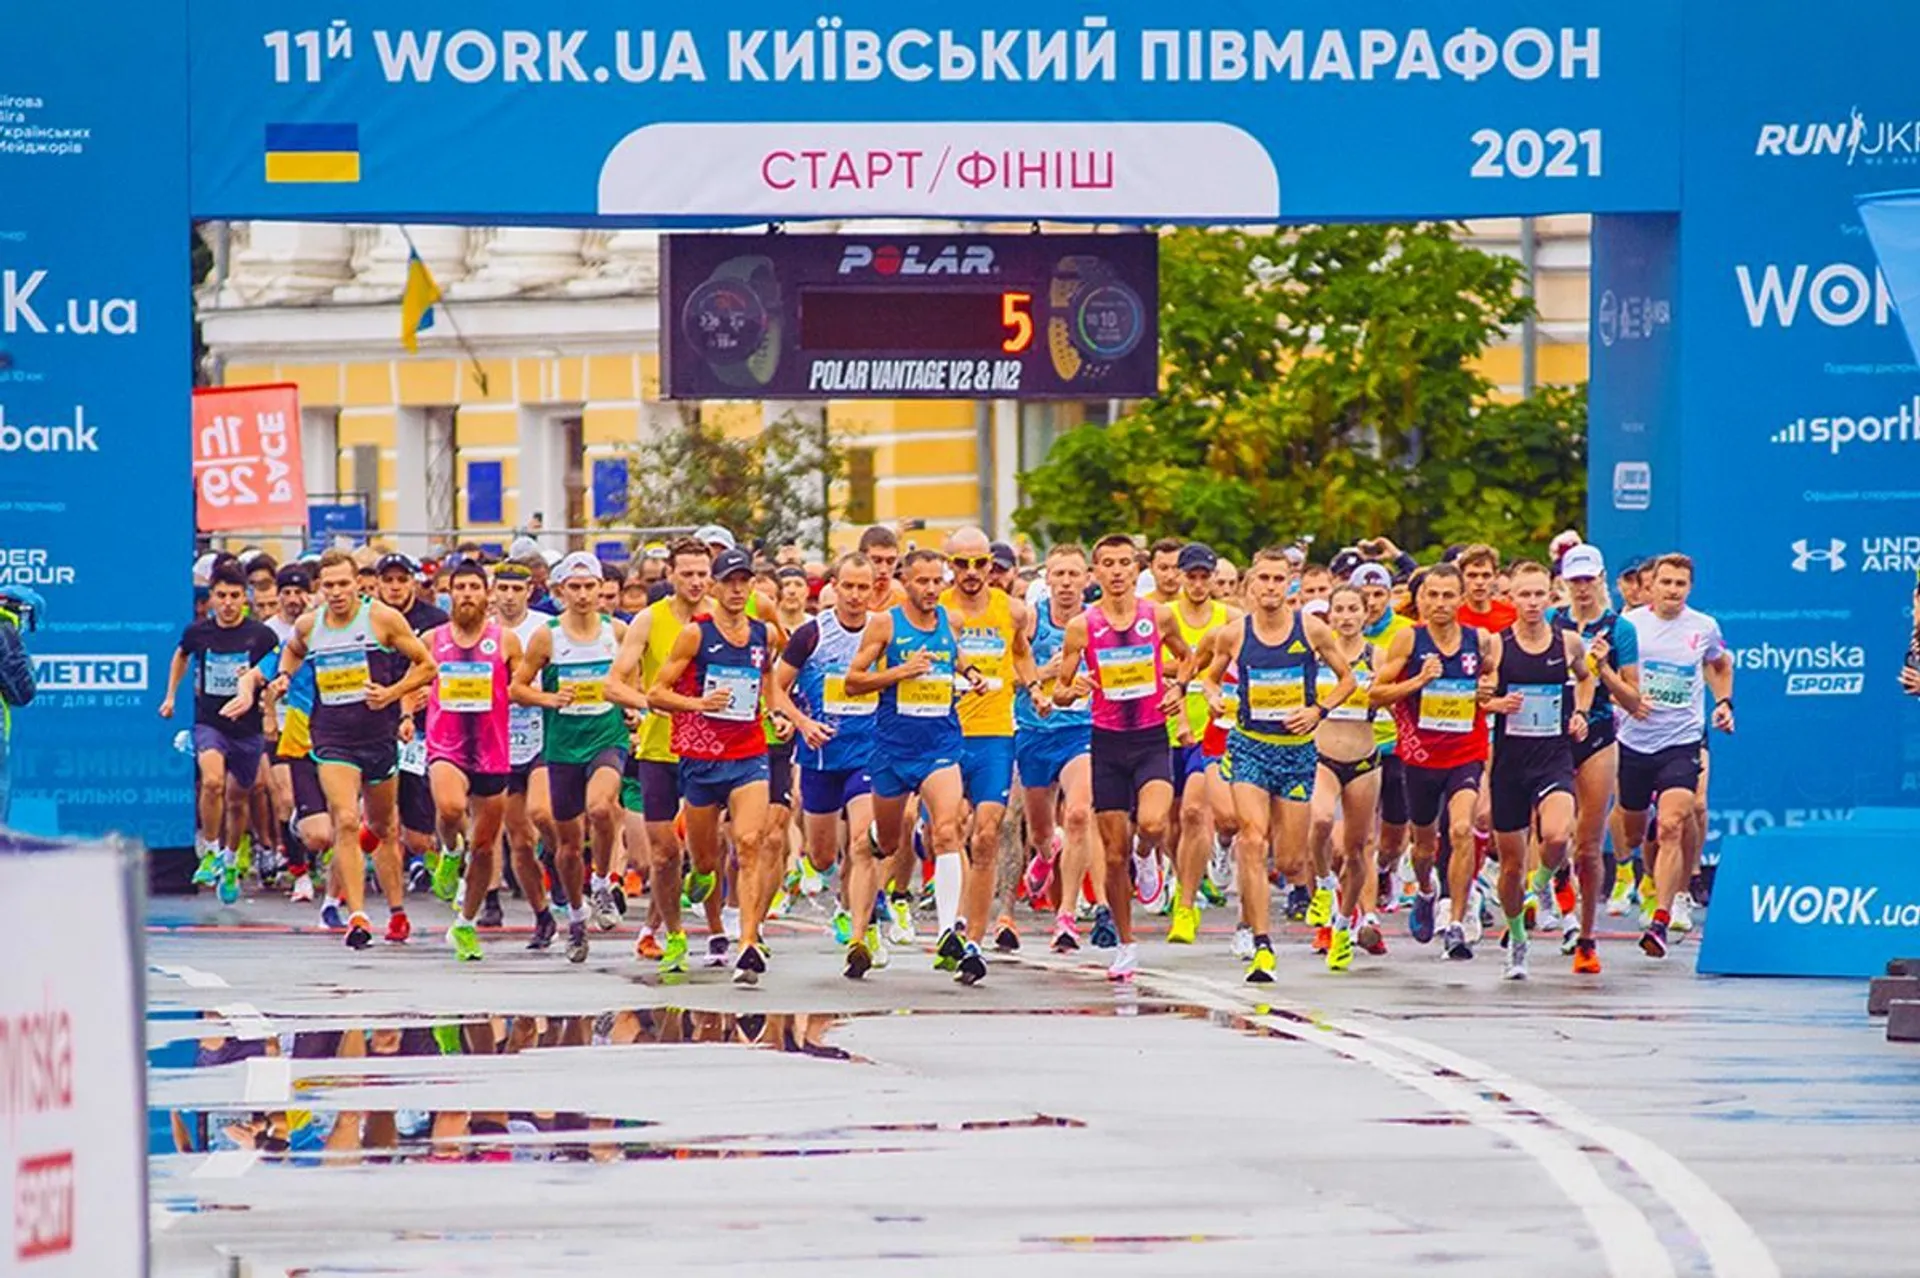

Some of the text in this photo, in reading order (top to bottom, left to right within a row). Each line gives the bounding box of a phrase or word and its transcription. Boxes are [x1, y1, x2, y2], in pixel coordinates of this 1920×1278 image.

[373, 30, 706, 83] WORK.UA
[729, 16, 1117, 81] КИЇВСЬКИЙ
[1141, 27, 1601, 81] ПІВМАРАФОН
[1470, 128, 1602, 178] 2021
[1755, 123, 1847, 156] RUN
[837, 245, 995, 275] POLAR
[3, 269, 138, 335] K.ua
[1002, 293, 1034, 352] 5
[809, 359, 1022, 391] POLAR VANTAGE V2 & M2
[1790, 678, 1861, 692] SPORT
[1751, 885, 1920, 927] WORK.ua
